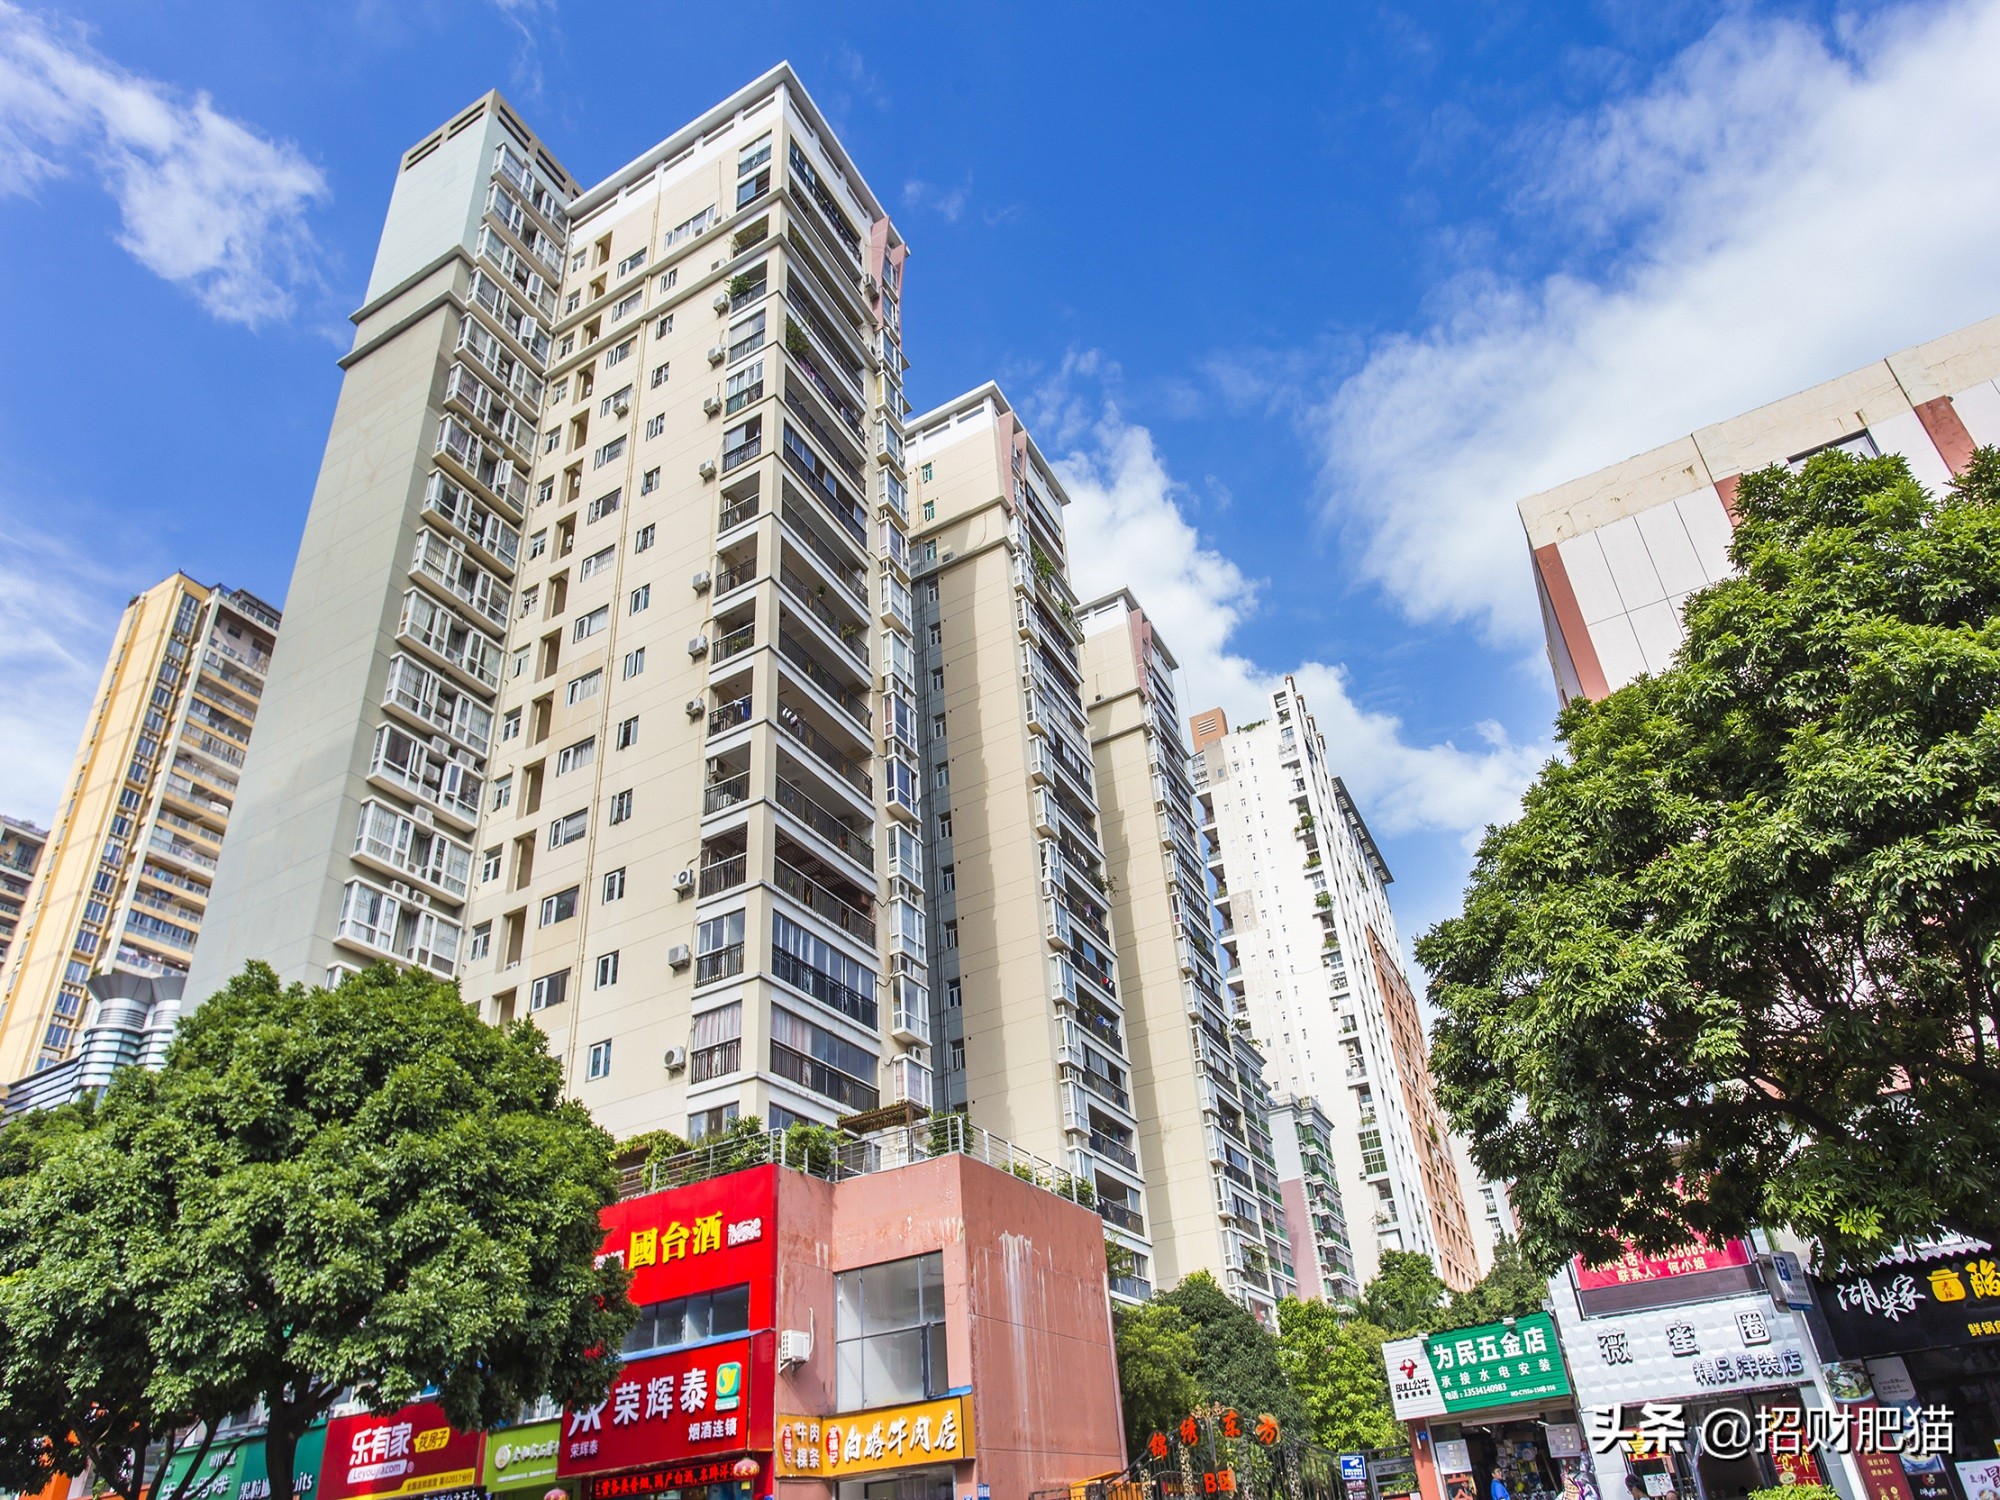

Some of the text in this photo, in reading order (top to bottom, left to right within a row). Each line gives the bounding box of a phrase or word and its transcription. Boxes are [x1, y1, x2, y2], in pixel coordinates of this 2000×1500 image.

[628, 1210, 723, 1269] 國台酒
[1776, 1259, 1787, 1278] P
[1433, 1326, 1547, 1370] 为民五金店
[1693, 1349, 1803, 1386] 精品洋装店
[1440, 1358, 1552, 1389] 承接水电安装
[613, 1368, 708, 1426] 荣辉泰
[349, 1422, 413, 1466] 乐有家
[688, 1417, 737, 1442] 烟酒连锁
[843, 1411, 956, 1463] 白塔牛肉店
